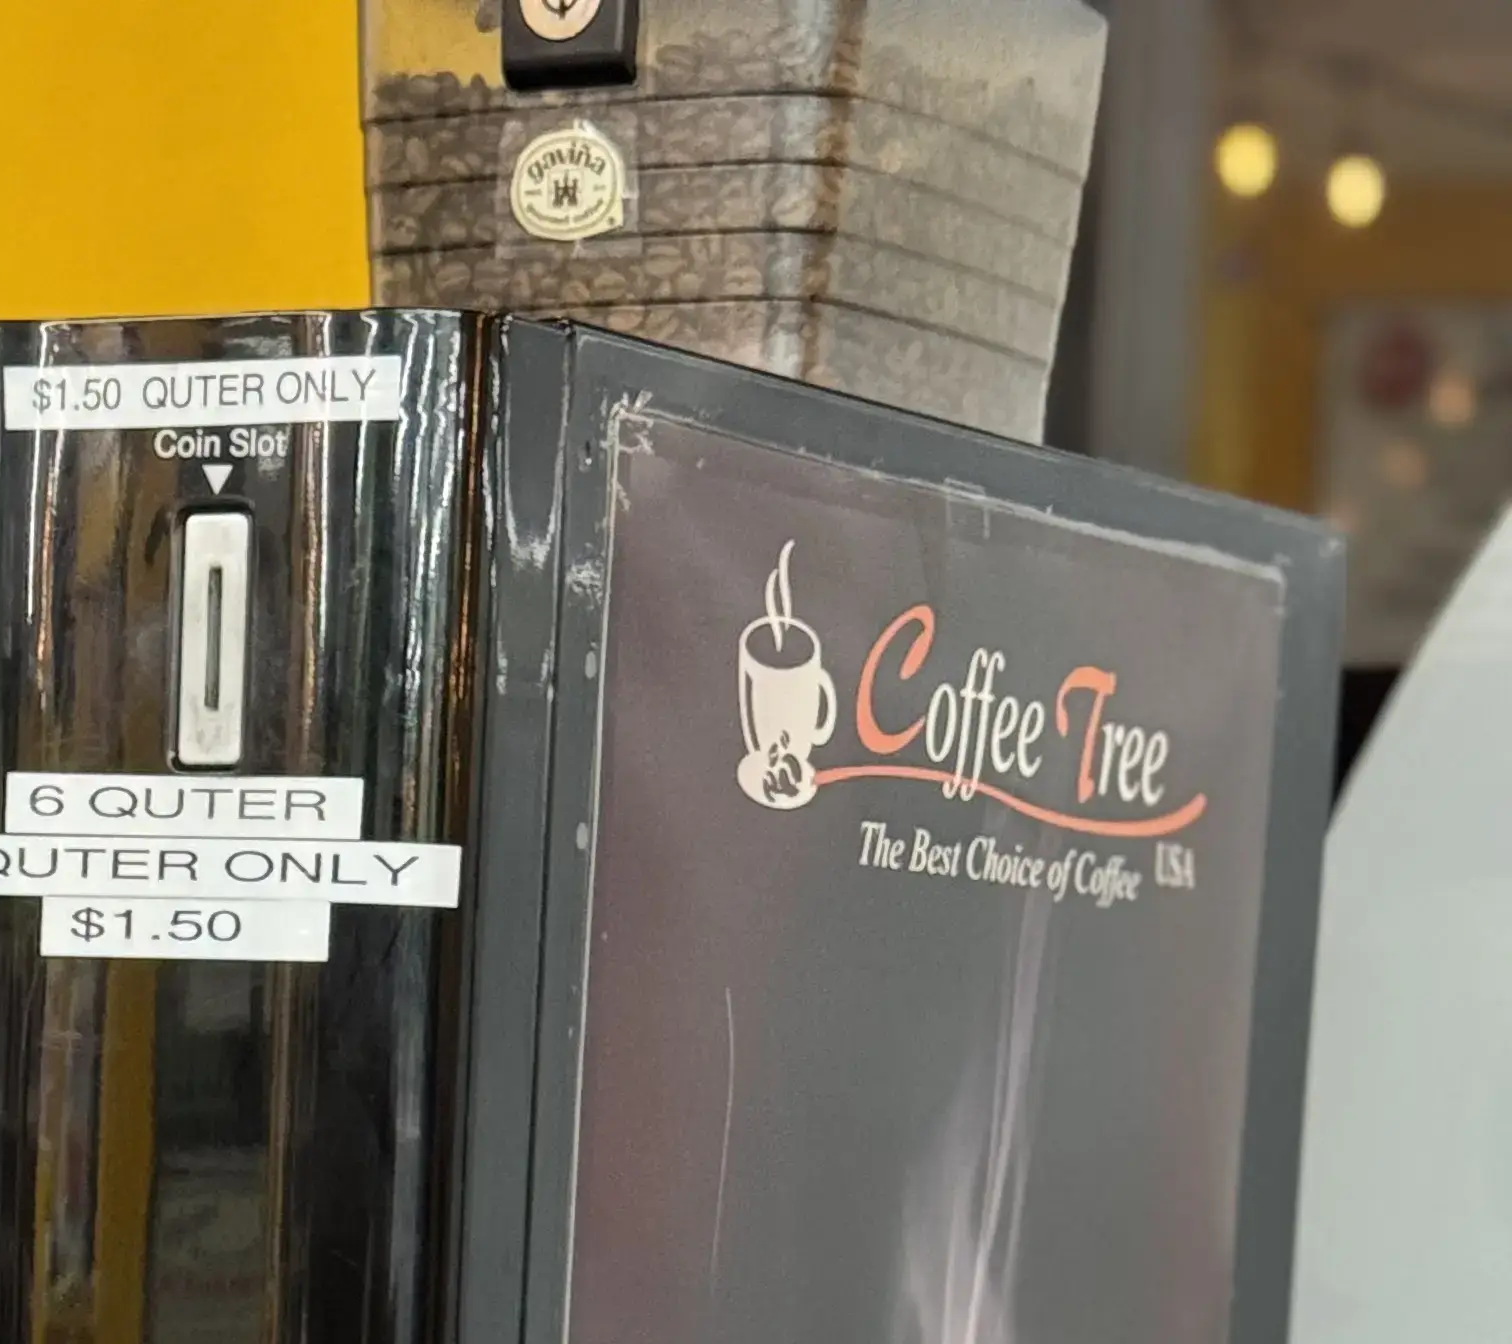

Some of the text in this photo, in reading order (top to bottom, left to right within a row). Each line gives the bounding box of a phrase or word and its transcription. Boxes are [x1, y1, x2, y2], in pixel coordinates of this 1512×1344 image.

[32, 368, 377, 413] $1.50 QUTER ONLY
[154, 428, 287, 459] Coin Slot
[854, 604, 1172, 806] Coffee Tree
[29, 784, 327, 823] 6 QUTER
[225, 849, 420, 889] ONLY
[859, 820, 1143, 908] The Best Choice of Coffee
[1154, 840, 1197, 890] USA
[70, 906, 242, 943] $1.50
